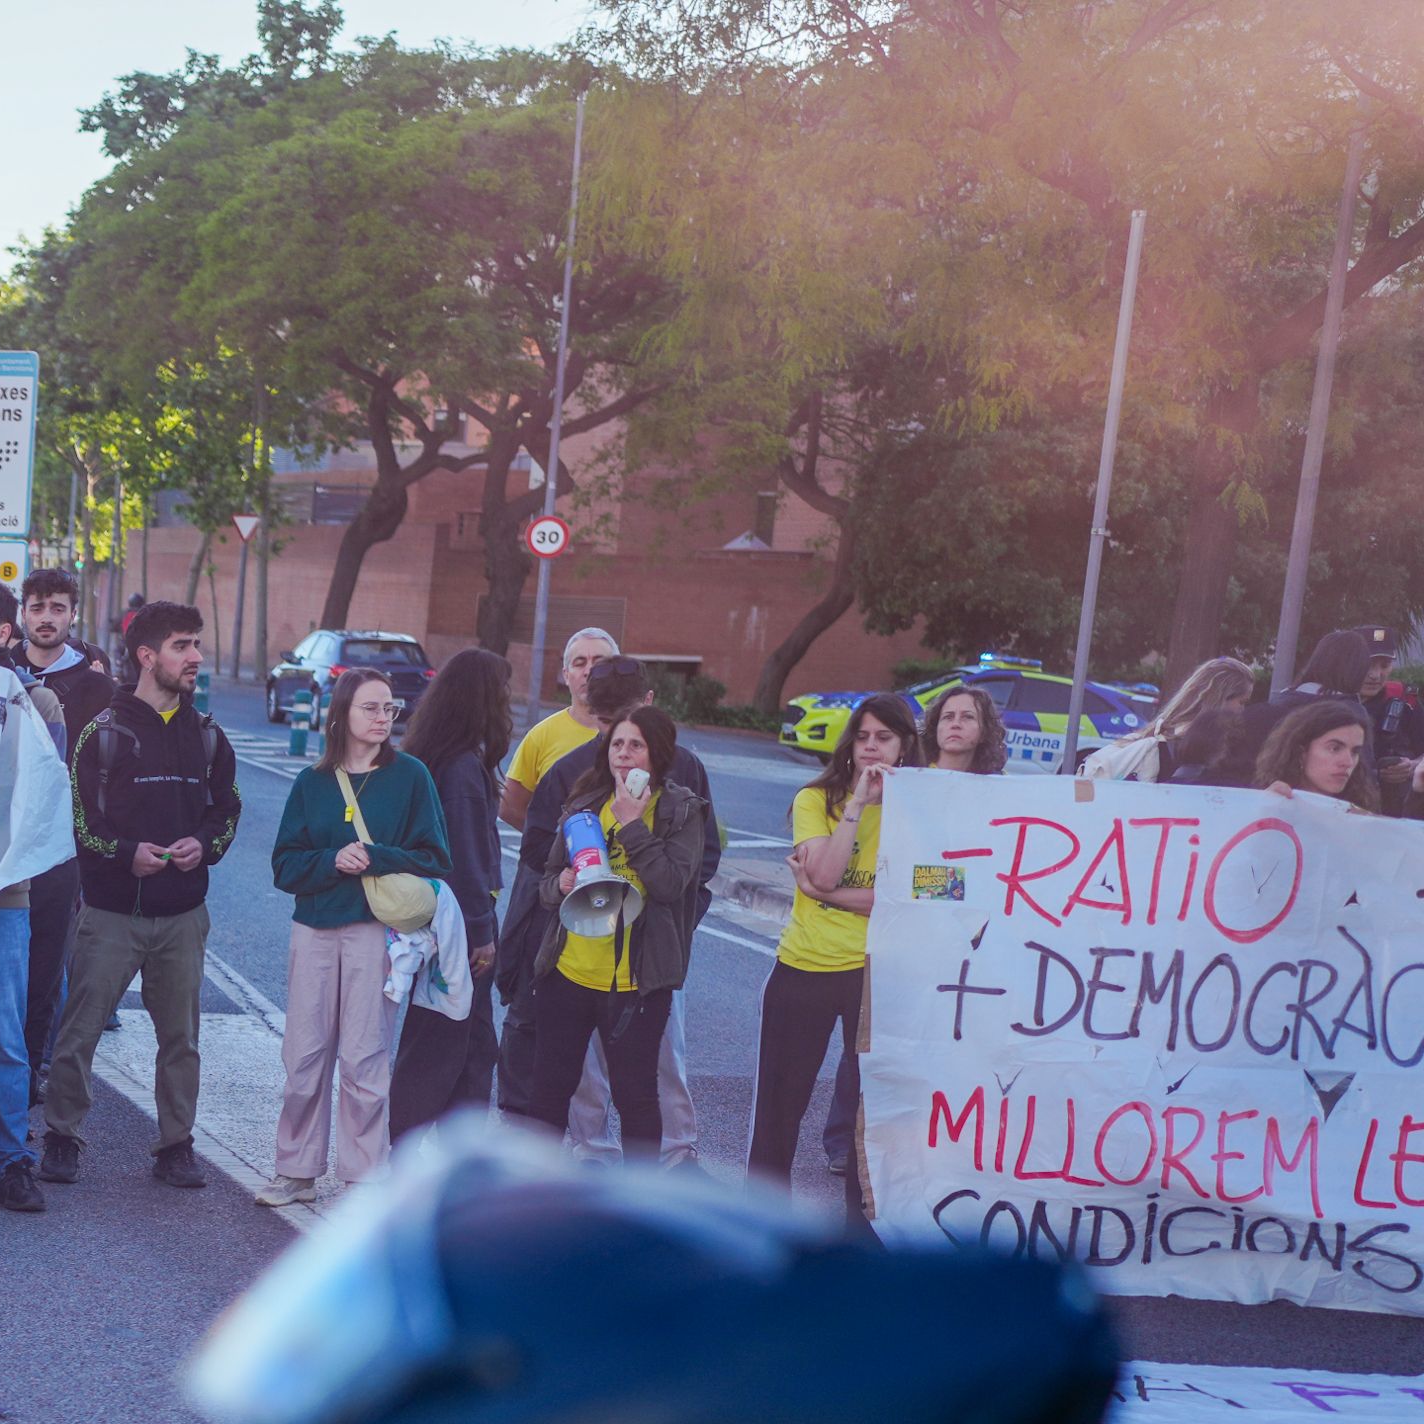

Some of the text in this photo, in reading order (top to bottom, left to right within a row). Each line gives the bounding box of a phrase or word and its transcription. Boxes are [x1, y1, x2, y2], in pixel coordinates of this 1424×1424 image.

[536, 531, 560, 544] 30
[3, 566, 12, 577] B
[1005, 731, 1060, 750] Urbana
[928, 1086, 1323, 1218] MILLOREM
